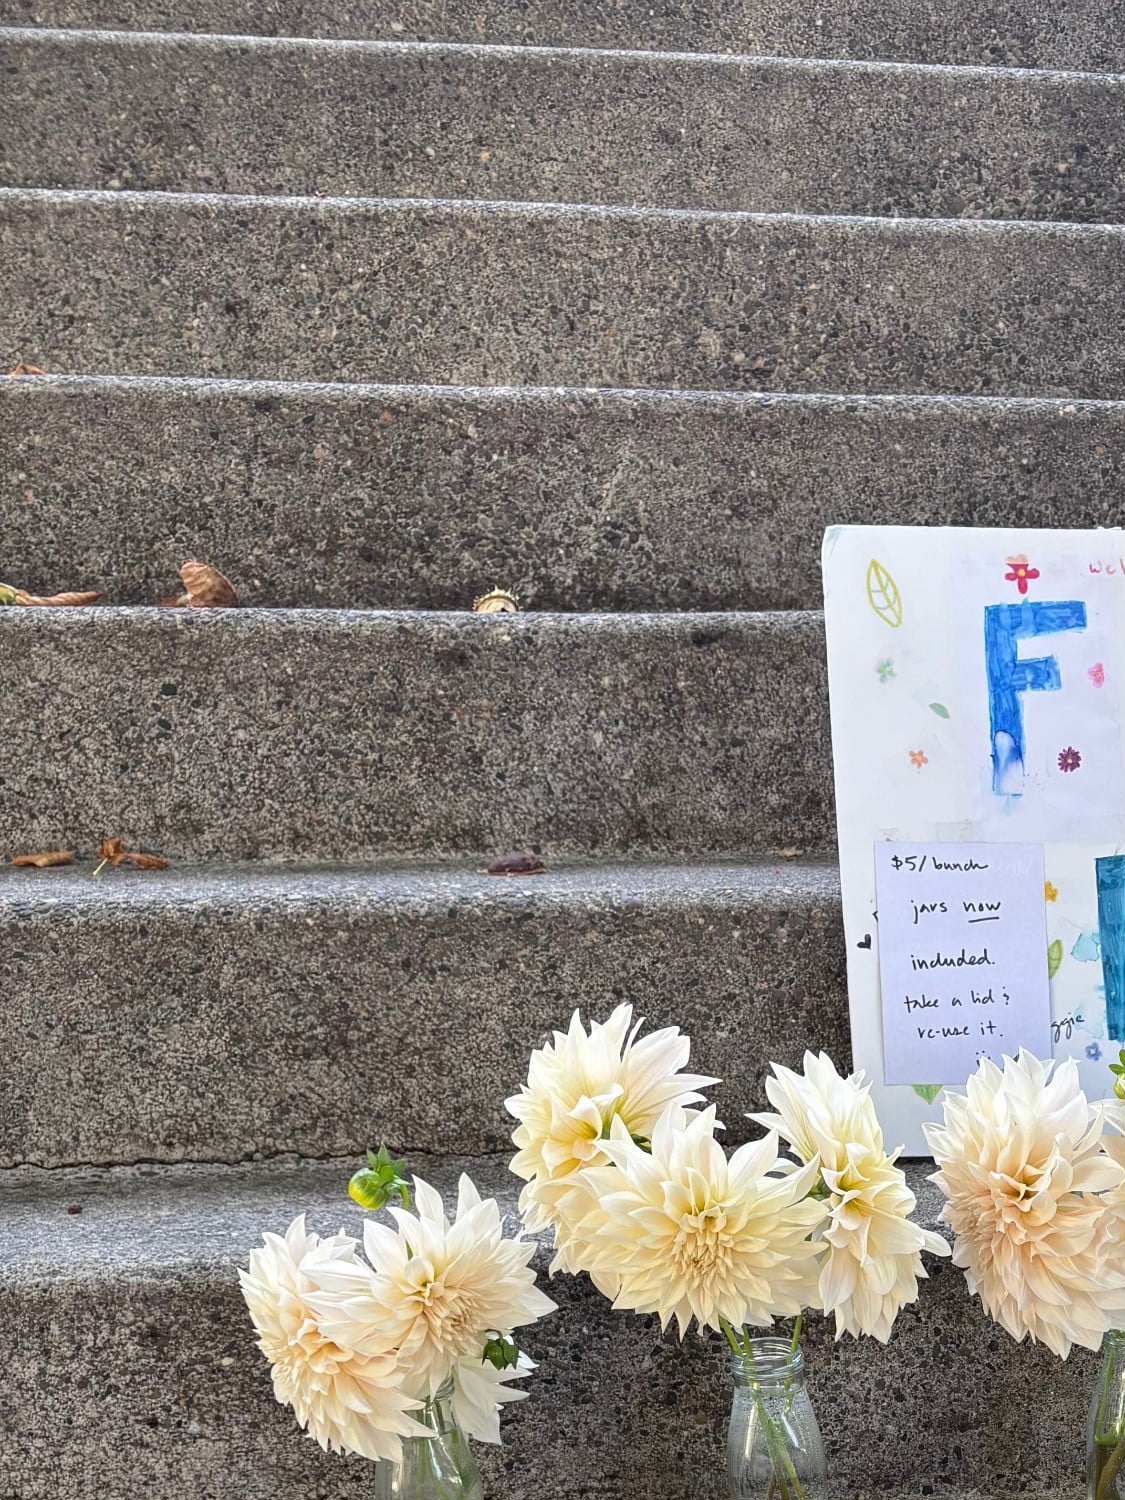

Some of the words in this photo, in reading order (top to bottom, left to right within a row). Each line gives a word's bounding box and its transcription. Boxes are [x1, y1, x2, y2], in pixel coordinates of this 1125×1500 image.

[910, 900, 948, 924] jars
[963, 901, 1001, 915] now
[910, 948, 996, 970] included.
[904, 995, 939, 1013] take
[951, 998, 963, 1007] a
[971, 988, 996, 1005] lid
[918, 1025, 970, 1039] re-use
[980, 1020, 1004, 1037] it.
